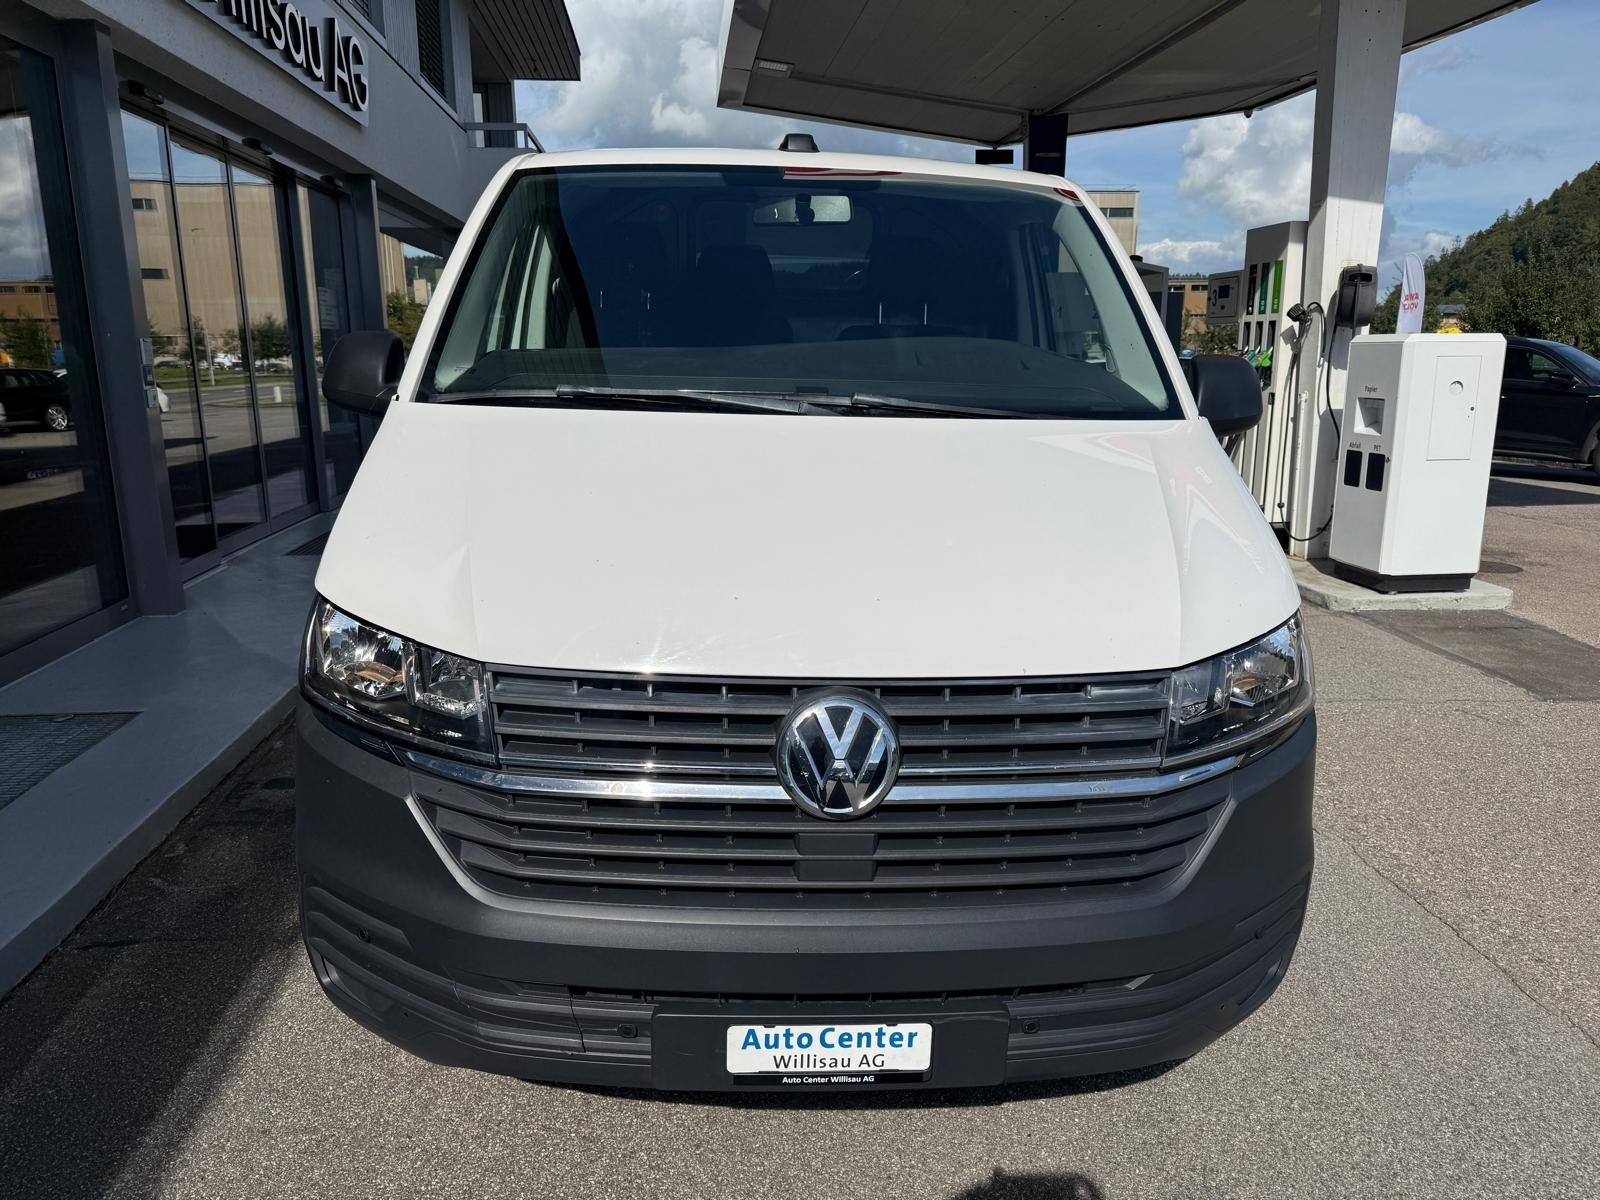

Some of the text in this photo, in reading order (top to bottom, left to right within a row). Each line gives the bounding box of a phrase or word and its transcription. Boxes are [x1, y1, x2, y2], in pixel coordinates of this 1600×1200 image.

[333, 17, 369, 112] AG
[1211, 289, 1218, 307] 3
[1364, 385, 1378, 395] Papier
[1373, 444, 1382, 452] PET
[741, 1027, 918, 1050] Auto Center
[773, 1053, 885, 1069] Willisau AG
[782, 1074, 875, 1084] Auto Center Willisau AG
